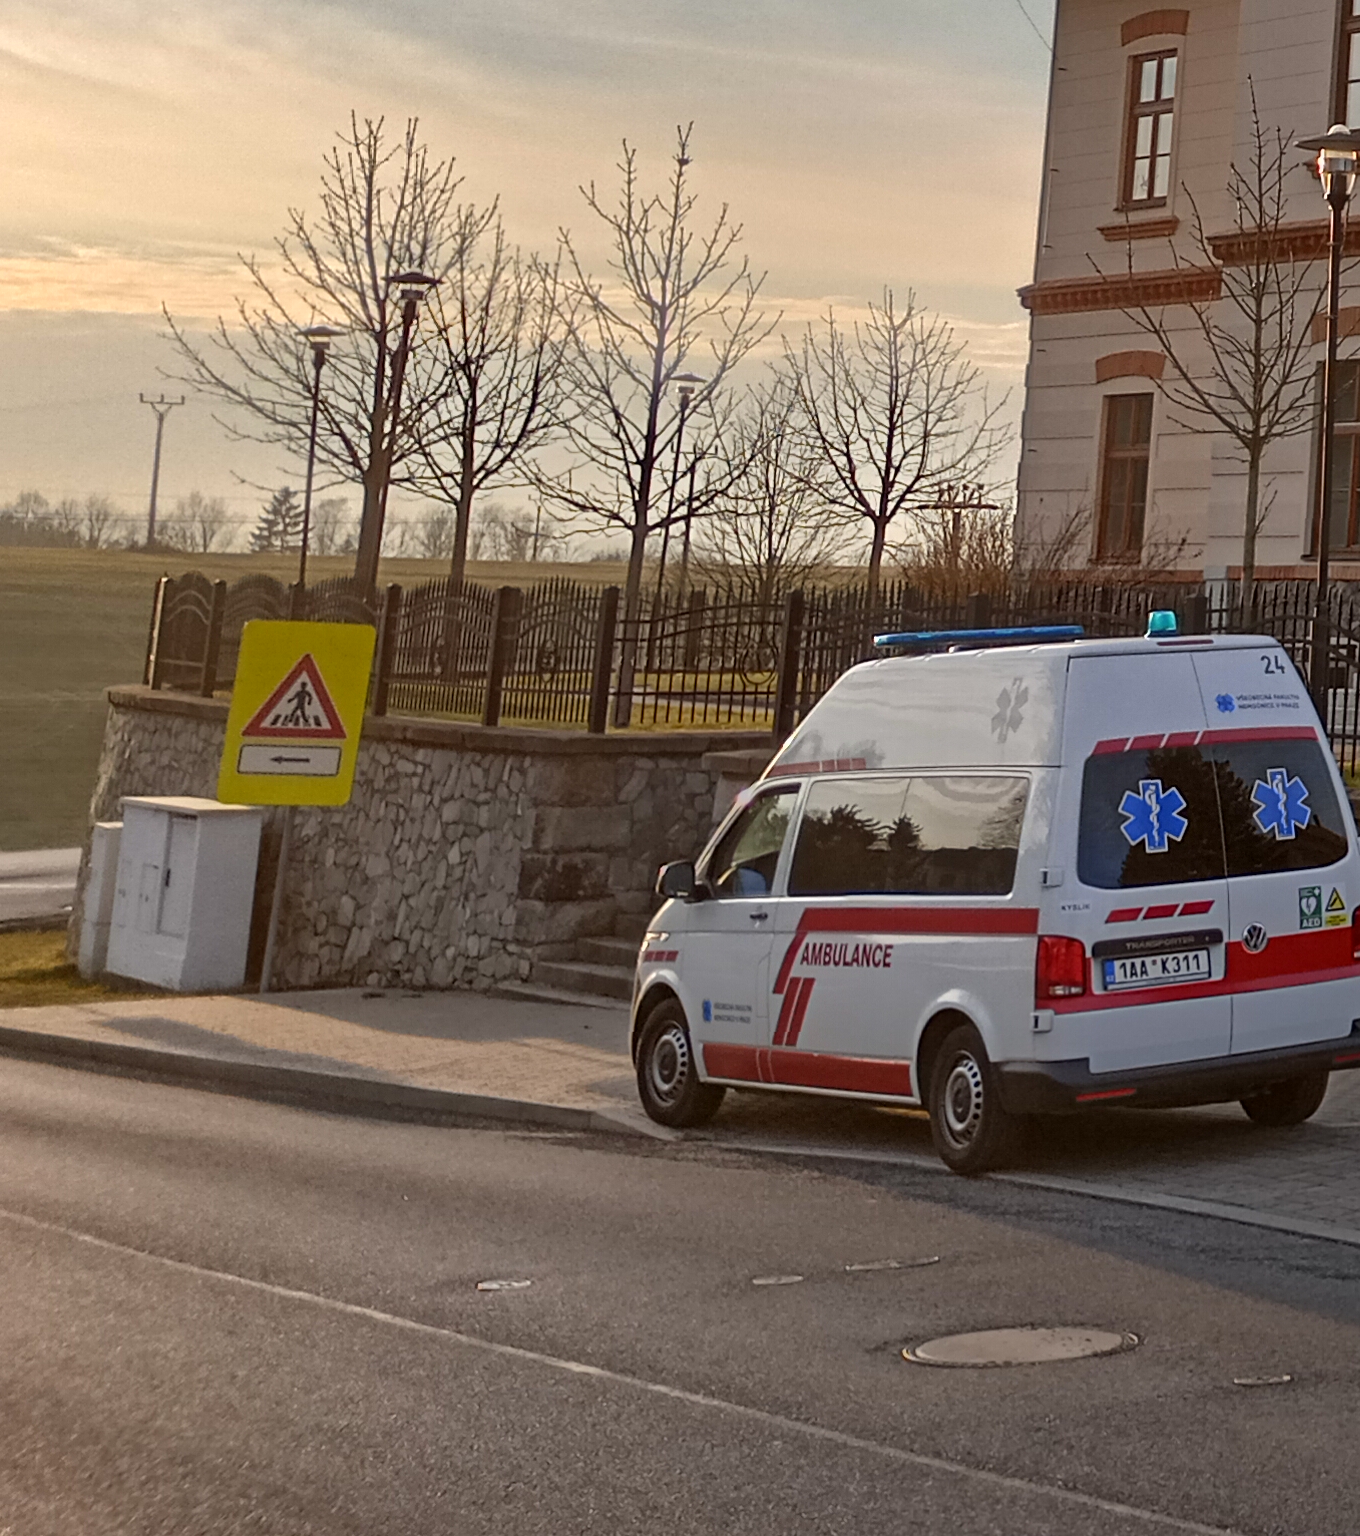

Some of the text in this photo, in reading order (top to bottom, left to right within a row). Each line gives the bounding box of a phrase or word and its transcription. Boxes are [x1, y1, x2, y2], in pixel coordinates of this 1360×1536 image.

[1260, 655, 1286, 675] 24
[1302, 917, 1321, 928] AED
[1125, 935, 1195, 950] TRANSPORTER
[800, 942, 894, 968] AMBULANCE
[1119, 953, 1200, 979] 1AA K311
